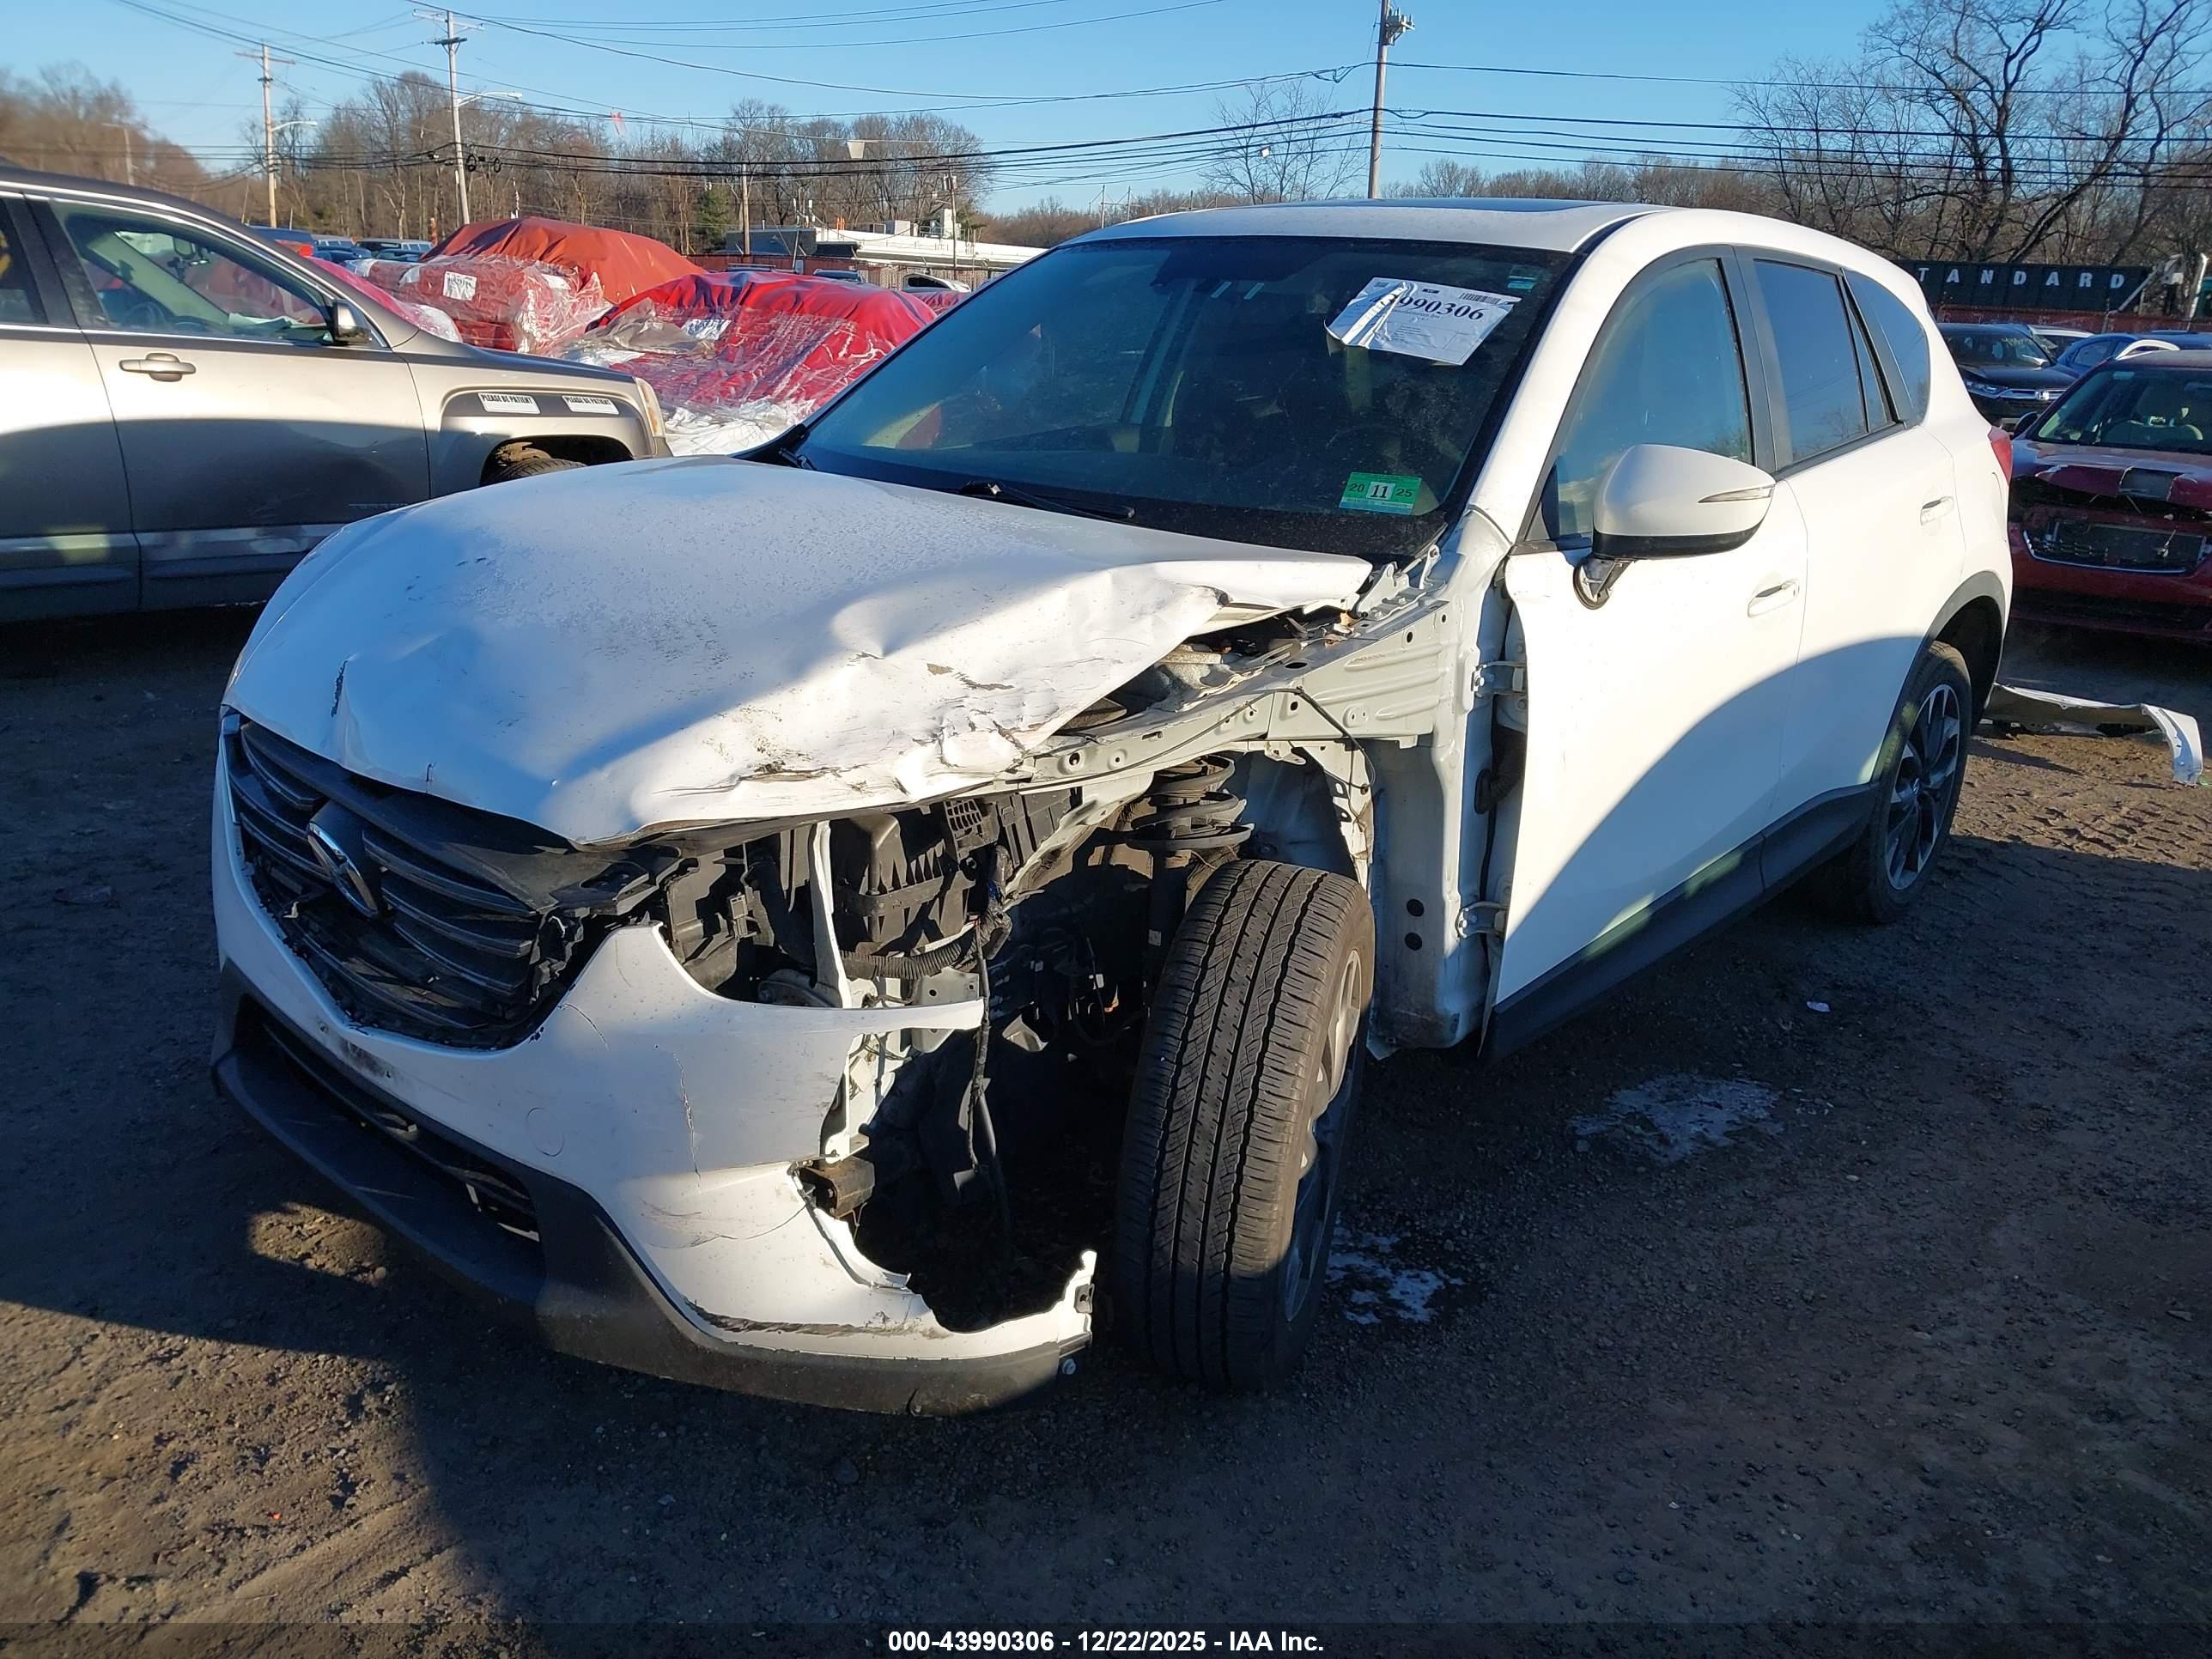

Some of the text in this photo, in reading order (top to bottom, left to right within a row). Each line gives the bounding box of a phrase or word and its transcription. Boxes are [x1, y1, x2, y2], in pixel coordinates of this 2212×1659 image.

[1917, 266, 2125, 289] TANDARD
[1370, 294, 1487, 320] 990306
[481, 394, 501, 403] PLEASE
[589, 398, 611, 406] PATIENT
[1349, 483, 1414, 498] 20 11 25
